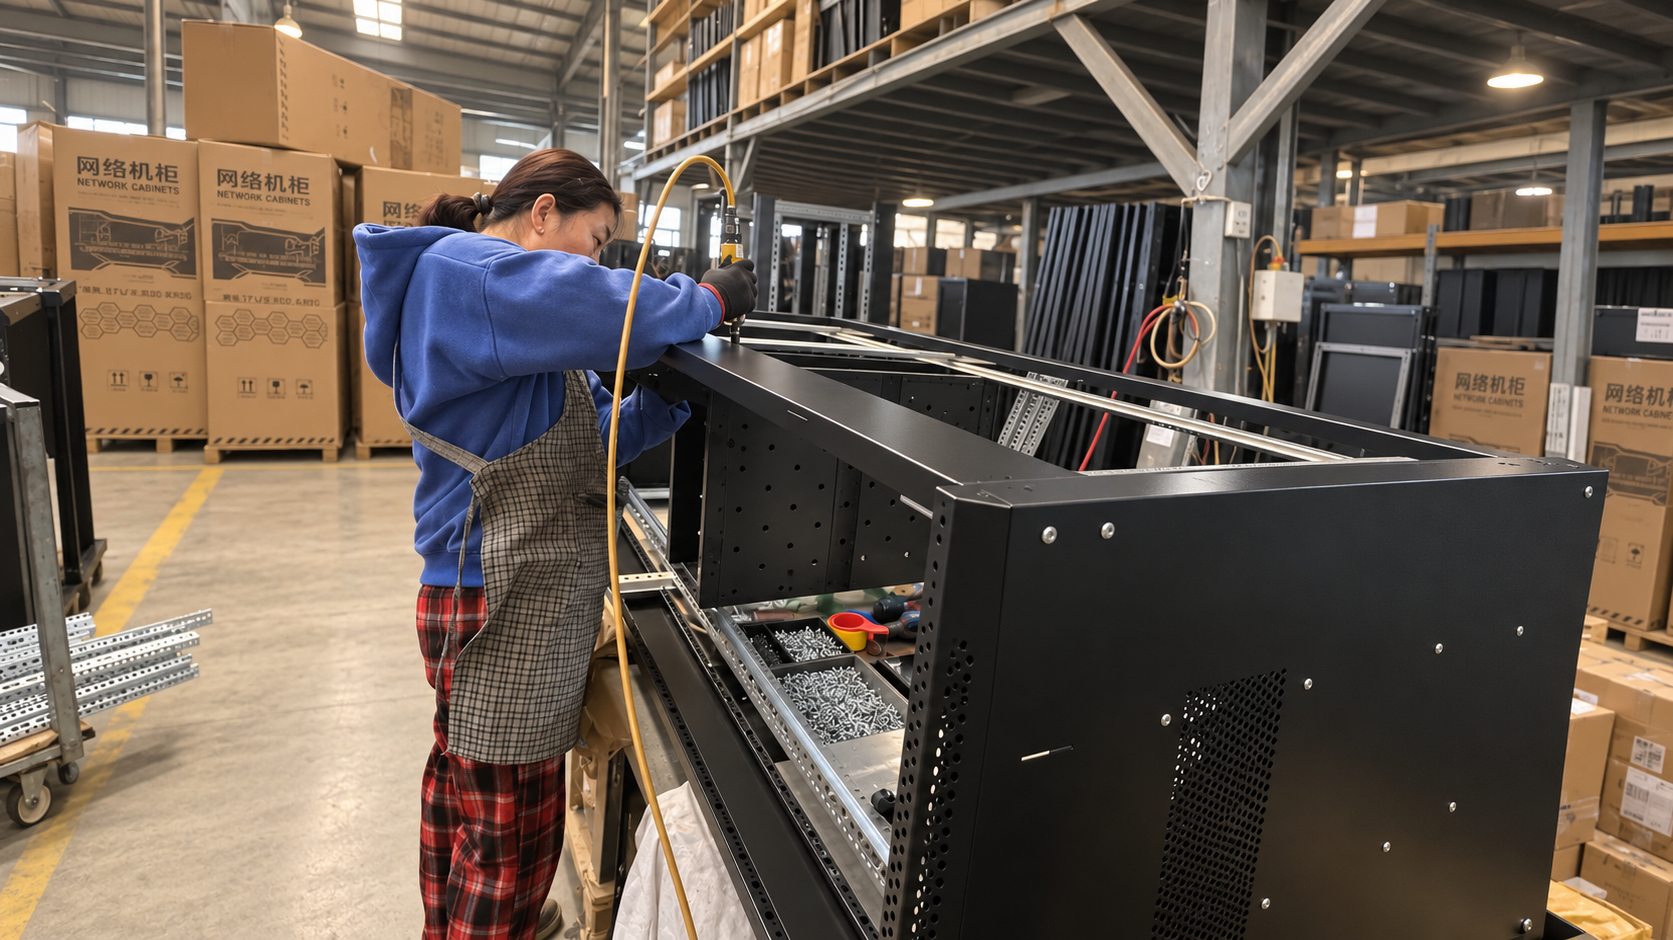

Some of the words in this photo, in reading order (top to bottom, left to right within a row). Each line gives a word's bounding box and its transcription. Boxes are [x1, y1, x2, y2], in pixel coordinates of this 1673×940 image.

[77, 156, 179, 184] 网络机柜
[77, 177, 128, 191] NETWORK
[131, 183, 180, 195] CABINETS
[217, 168, 310, 195] 网络机柜
[217, 190, 263, 202] NETWORK
[265, 195, 311, 207] CABINETS
[1455, 372, 1526, 396] 网络机柜
[1453, 393, 1486, 404] NETWORK
[1488, 396, 1524, 408] CABINETS
[1602, 405, 1641, 416] NETWORK
